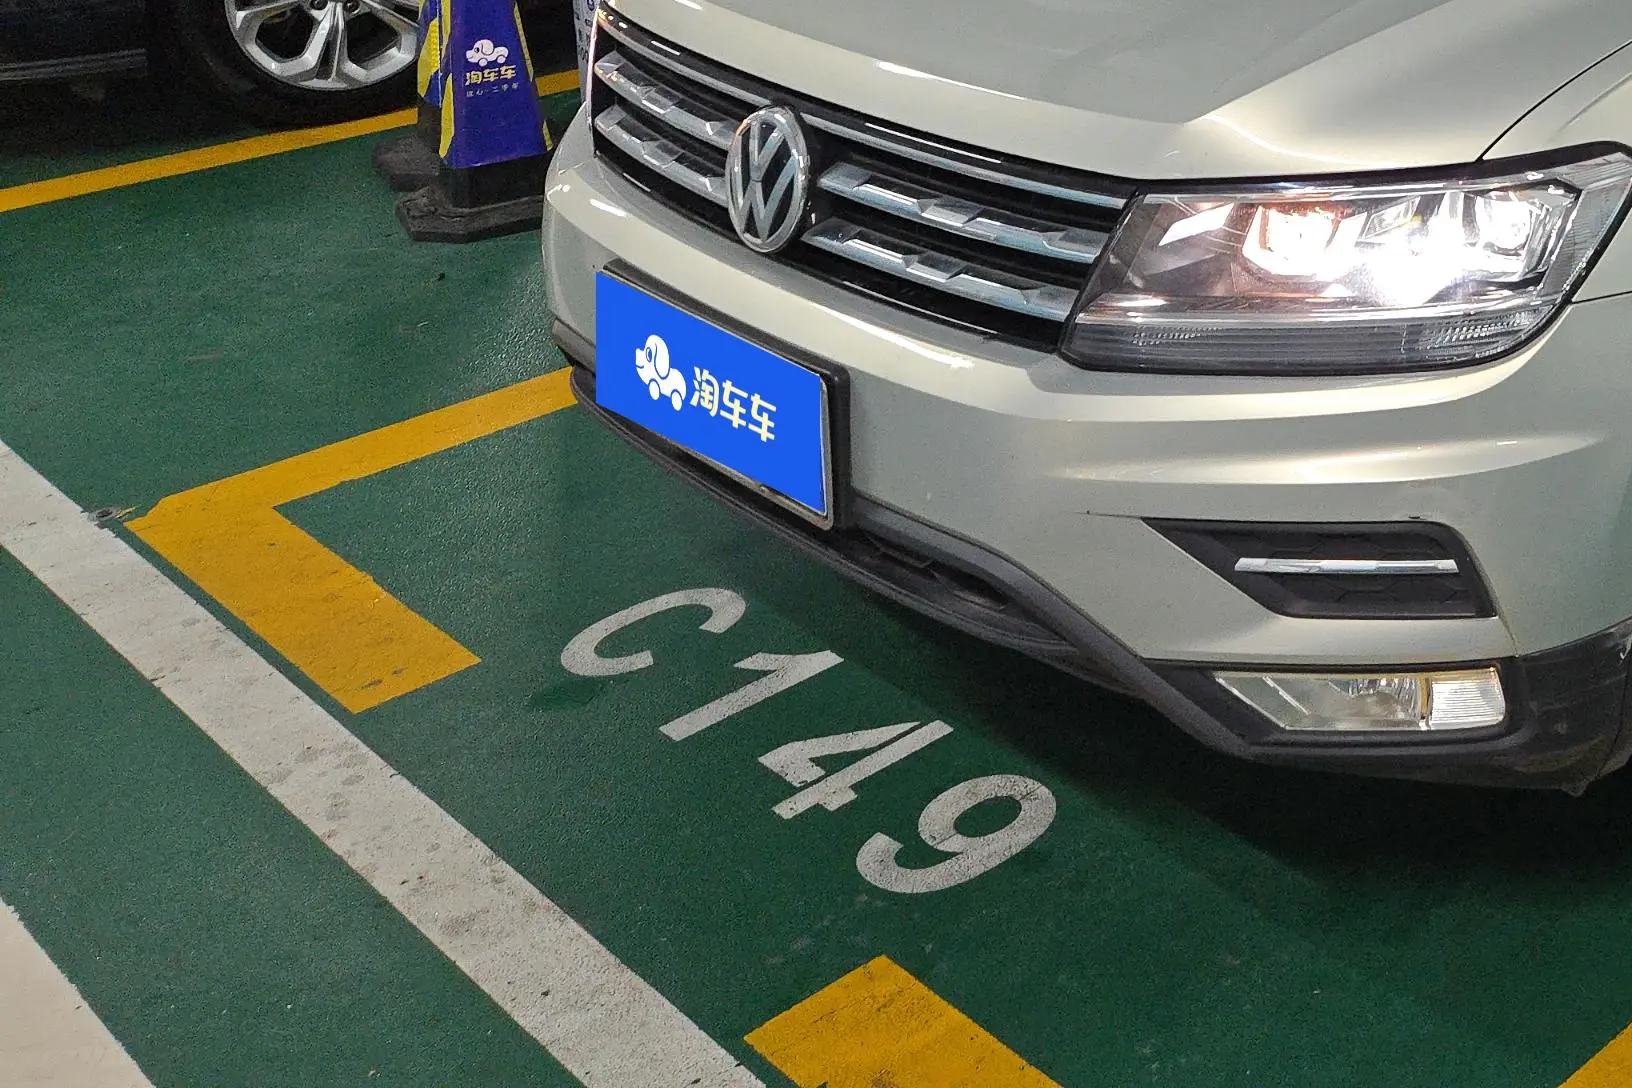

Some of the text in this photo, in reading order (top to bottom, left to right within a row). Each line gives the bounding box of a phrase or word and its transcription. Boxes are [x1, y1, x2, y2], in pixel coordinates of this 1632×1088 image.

[465, 65, 516, 86] 淘车车
[560, 587, 1057, 894] C149
